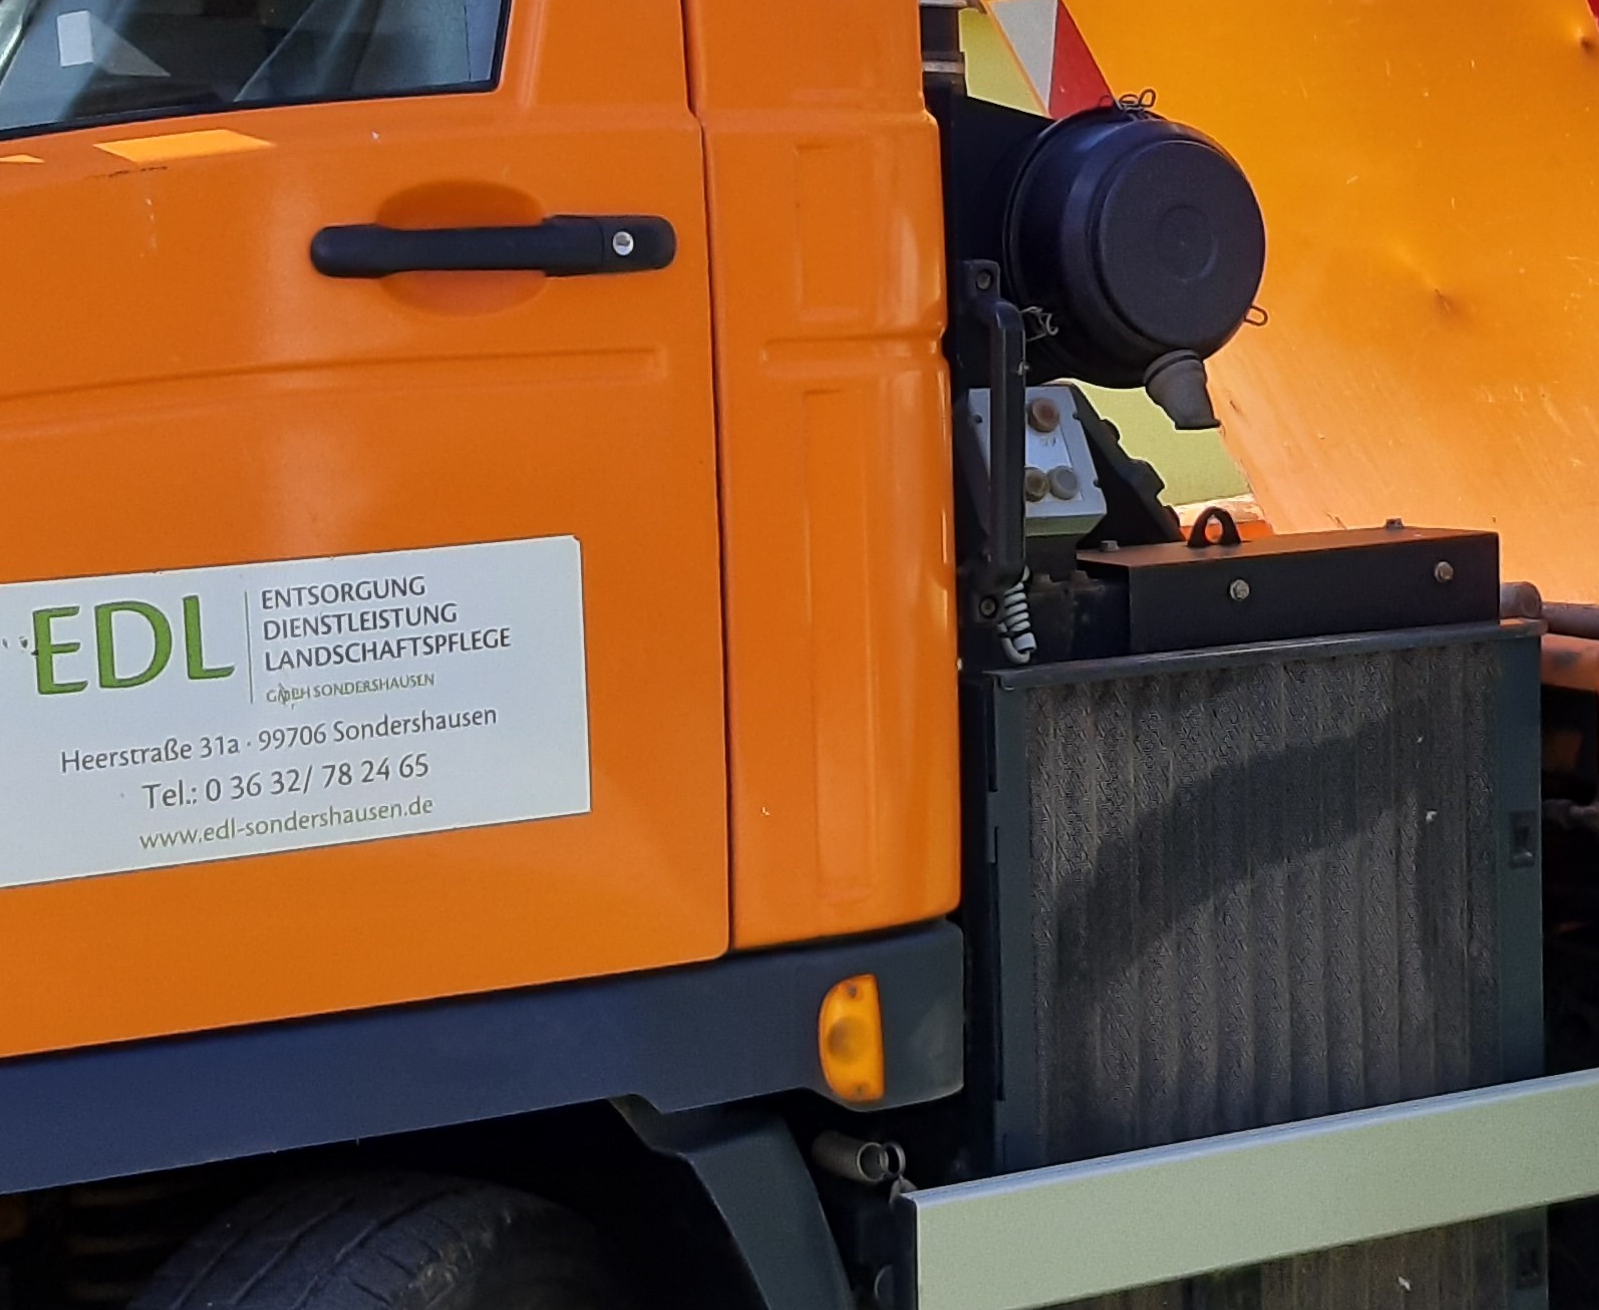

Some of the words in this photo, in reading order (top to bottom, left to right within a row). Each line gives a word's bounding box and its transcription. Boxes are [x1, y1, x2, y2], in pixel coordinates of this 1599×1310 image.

[261, 575, 426, 611] ENTSORGUNG
[31, 593, 236, 696] EDL
[262, 601, 458, 642] DIENSTLEISTUNG
[264, 627, 512, 672] LANDSCHAFTSPFLEGE
[313, 673, 436, 698] SONDERSHAUSEN
[61, 737, 193, 773] Heerstraße
[199, 735, 240, 759] 31a
[258, 722, 327, 752] 99706
[332, 708, 498, 743] Sondershausen
[141, 779, 198, 810] Tel.:
[205, 778, 222, 802] 0
[229, 771, 262, 800] 36
[321, 762, 352, 789] 78
[360, 756, 390, 783] 24
[399, 752, 429, 778] 65
[139, 795, 433, 850] www.edl-sondershausen.de
